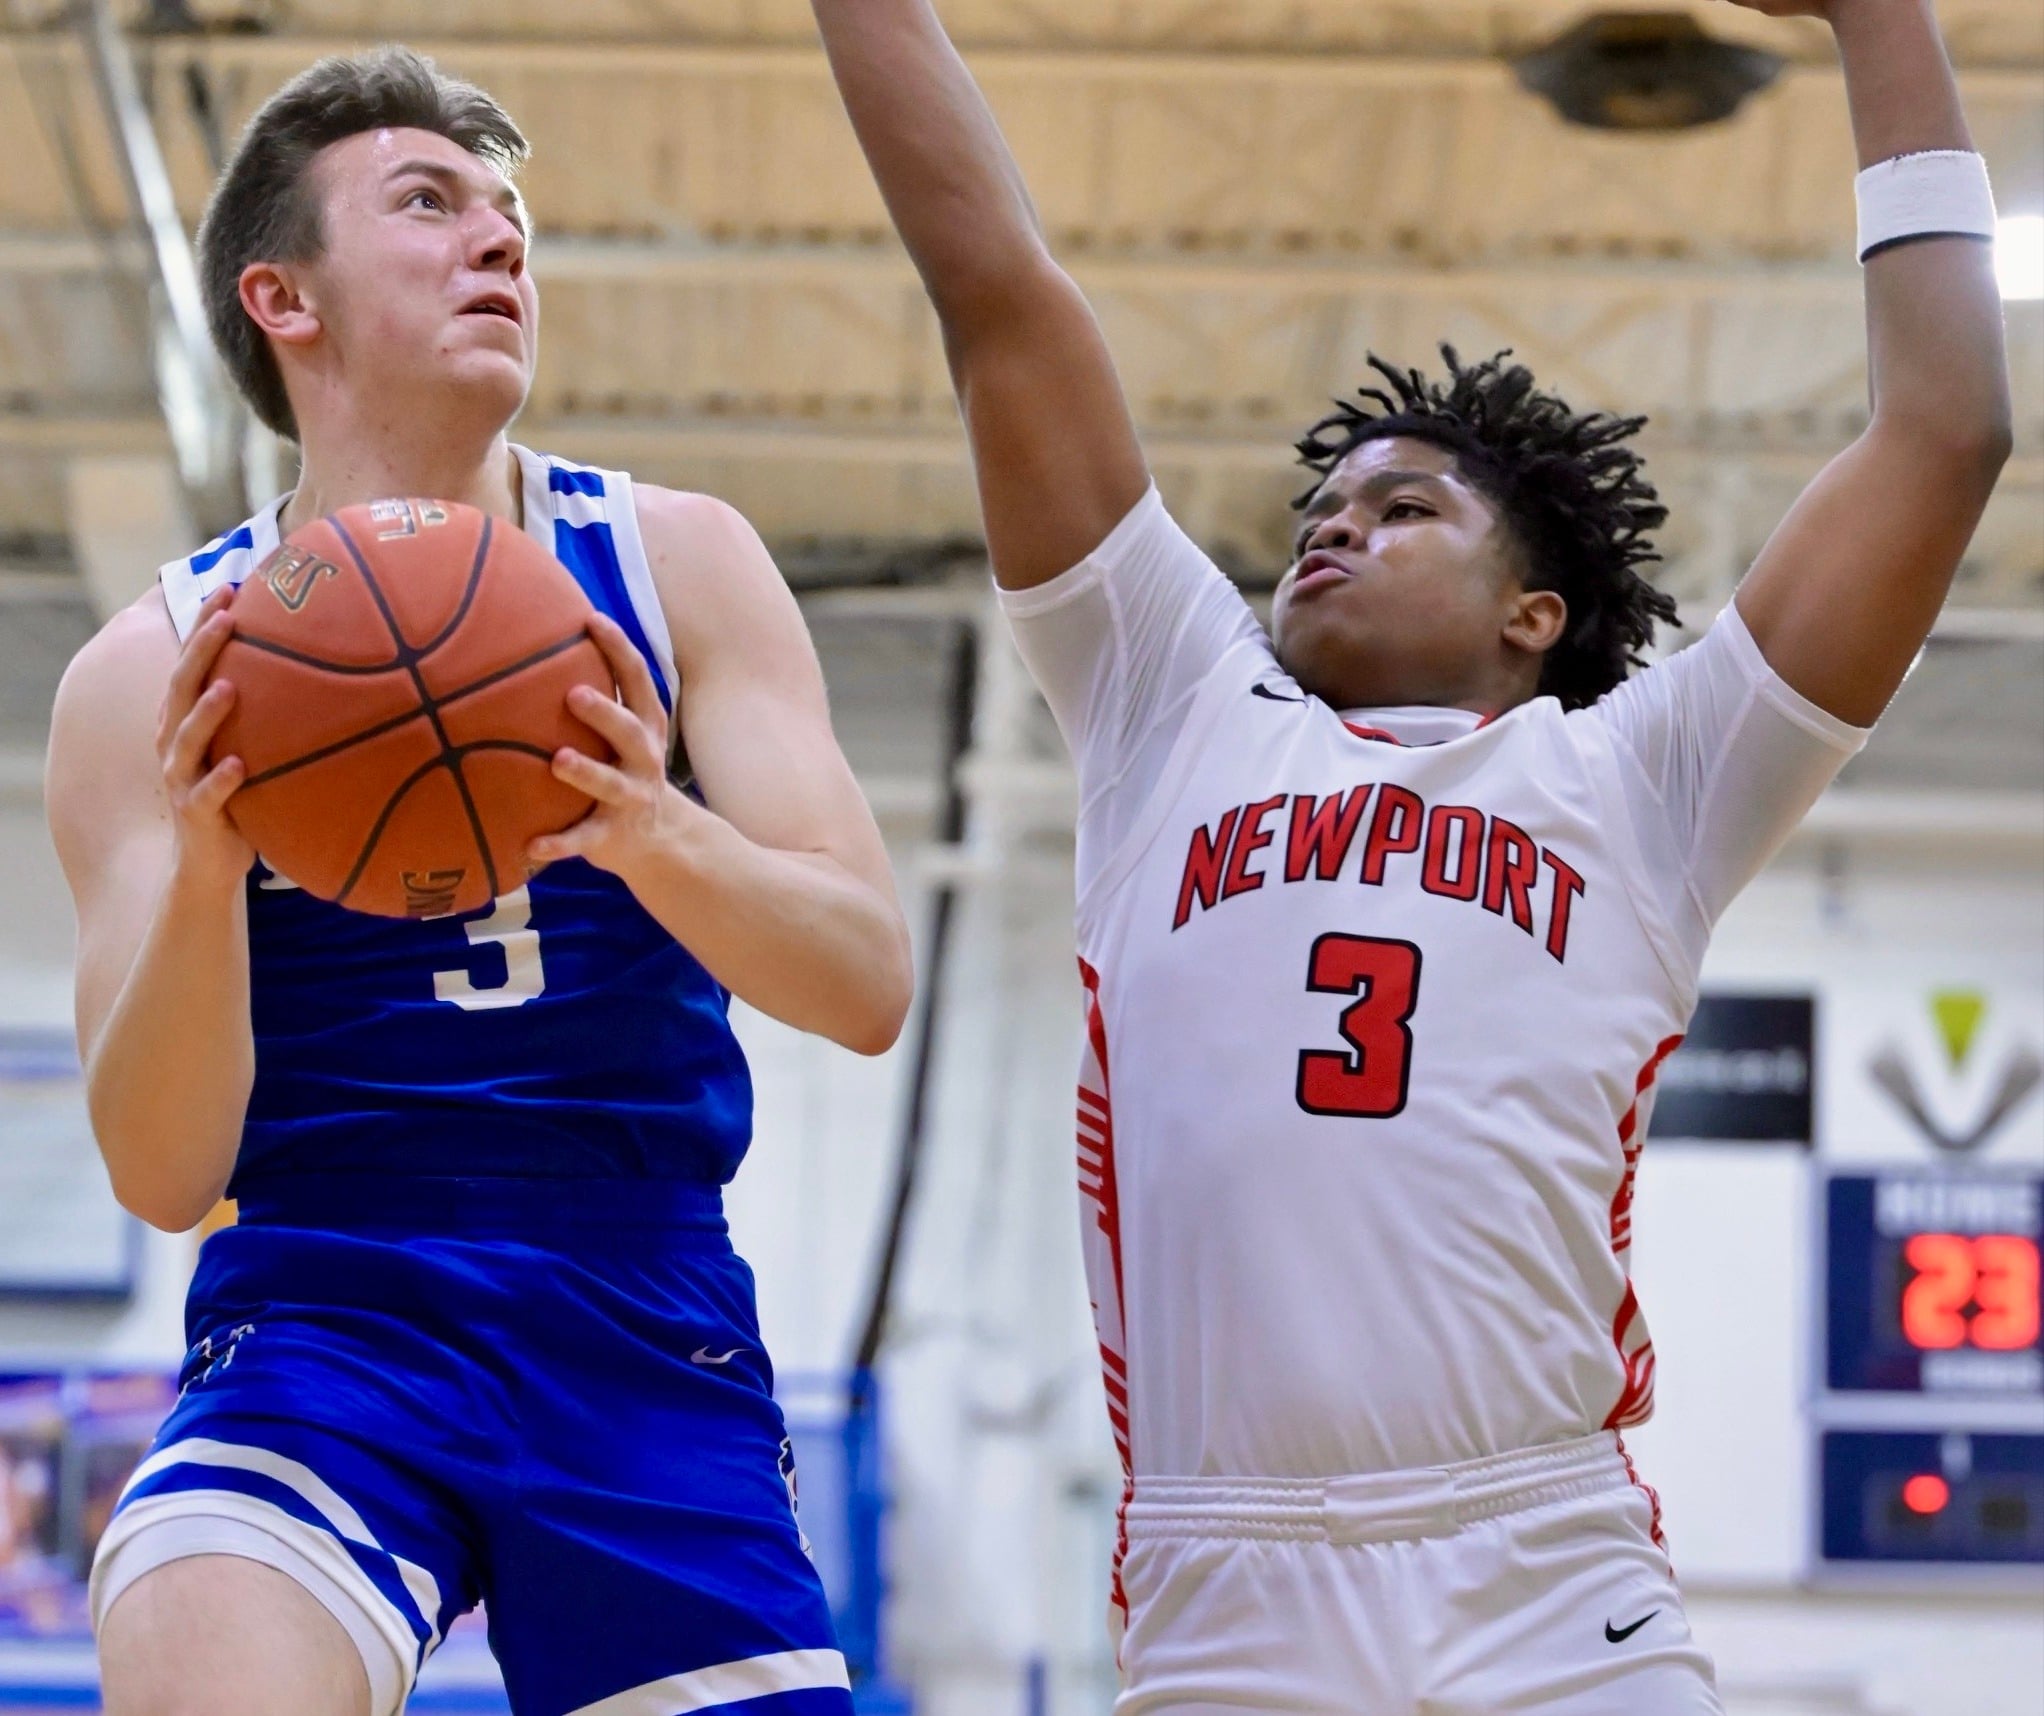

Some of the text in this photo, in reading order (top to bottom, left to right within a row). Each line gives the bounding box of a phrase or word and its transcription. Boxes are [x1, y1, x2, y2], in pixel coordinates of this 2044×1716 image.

[1172, 782, 1586, 964] NEWPORT
[1296, 931, 1423, 1119] 3
[1902, 1232, 2041, 1350] 23
